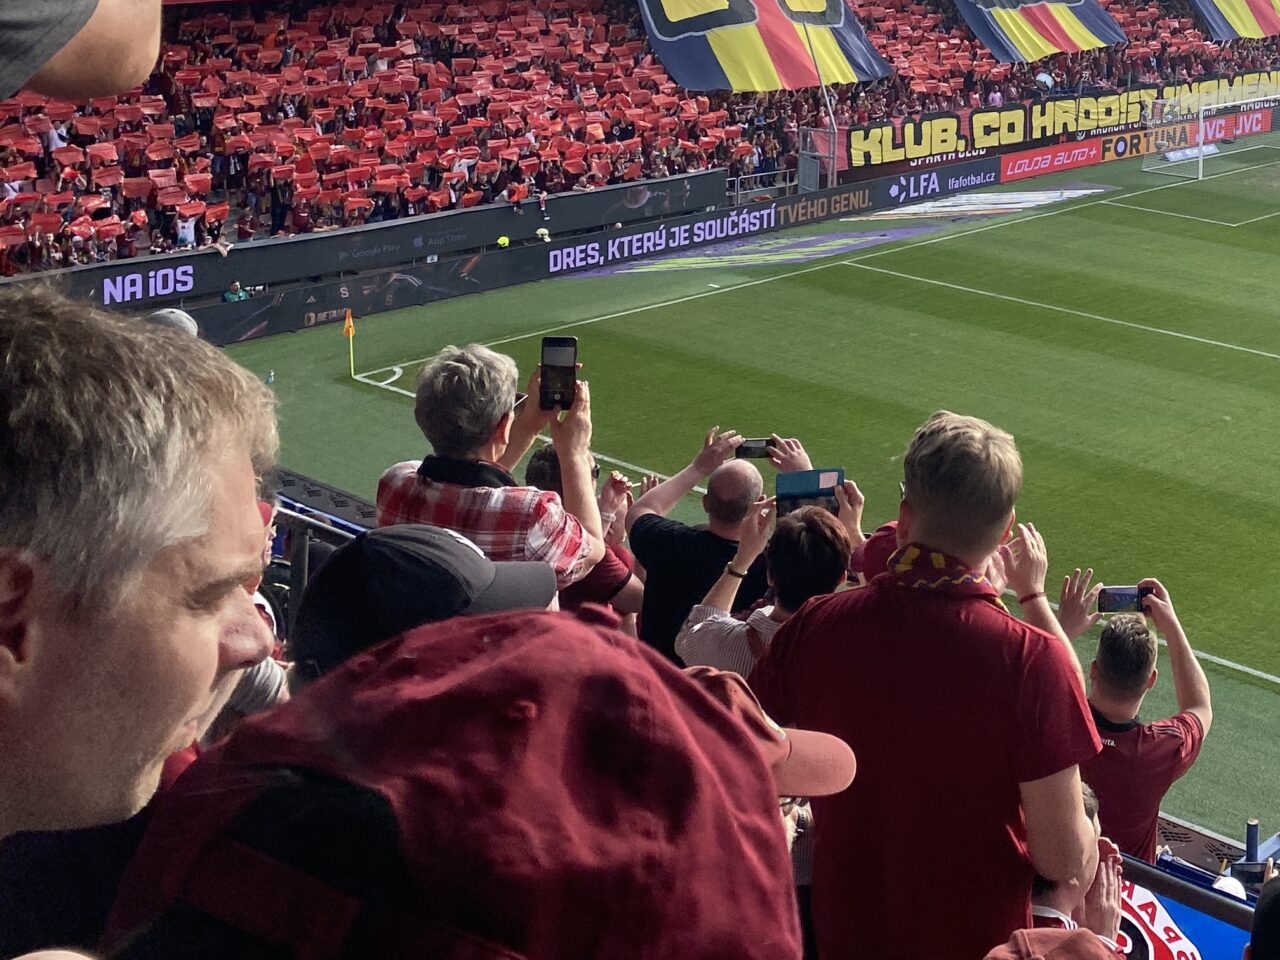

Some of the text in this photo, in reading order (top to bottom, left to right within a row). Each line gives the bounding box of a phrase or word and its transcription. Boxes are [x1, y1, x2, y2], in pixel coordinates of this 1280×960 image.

[850, 117, 967, 167] KLUB,
[972, 108, 1025, 149] CO
[1101, 125, 1189, 161] FORTUNA
[1233, 113, 1263, 136] JVC
[909, 171, 996, 198] LFA lfafotbal.cz
[549, 189, 873, 273] DRES, KTERÝ JE SOUČÁSTÍ TVÉHO GENU.
[103, 265, 194, 306] NA iOS
